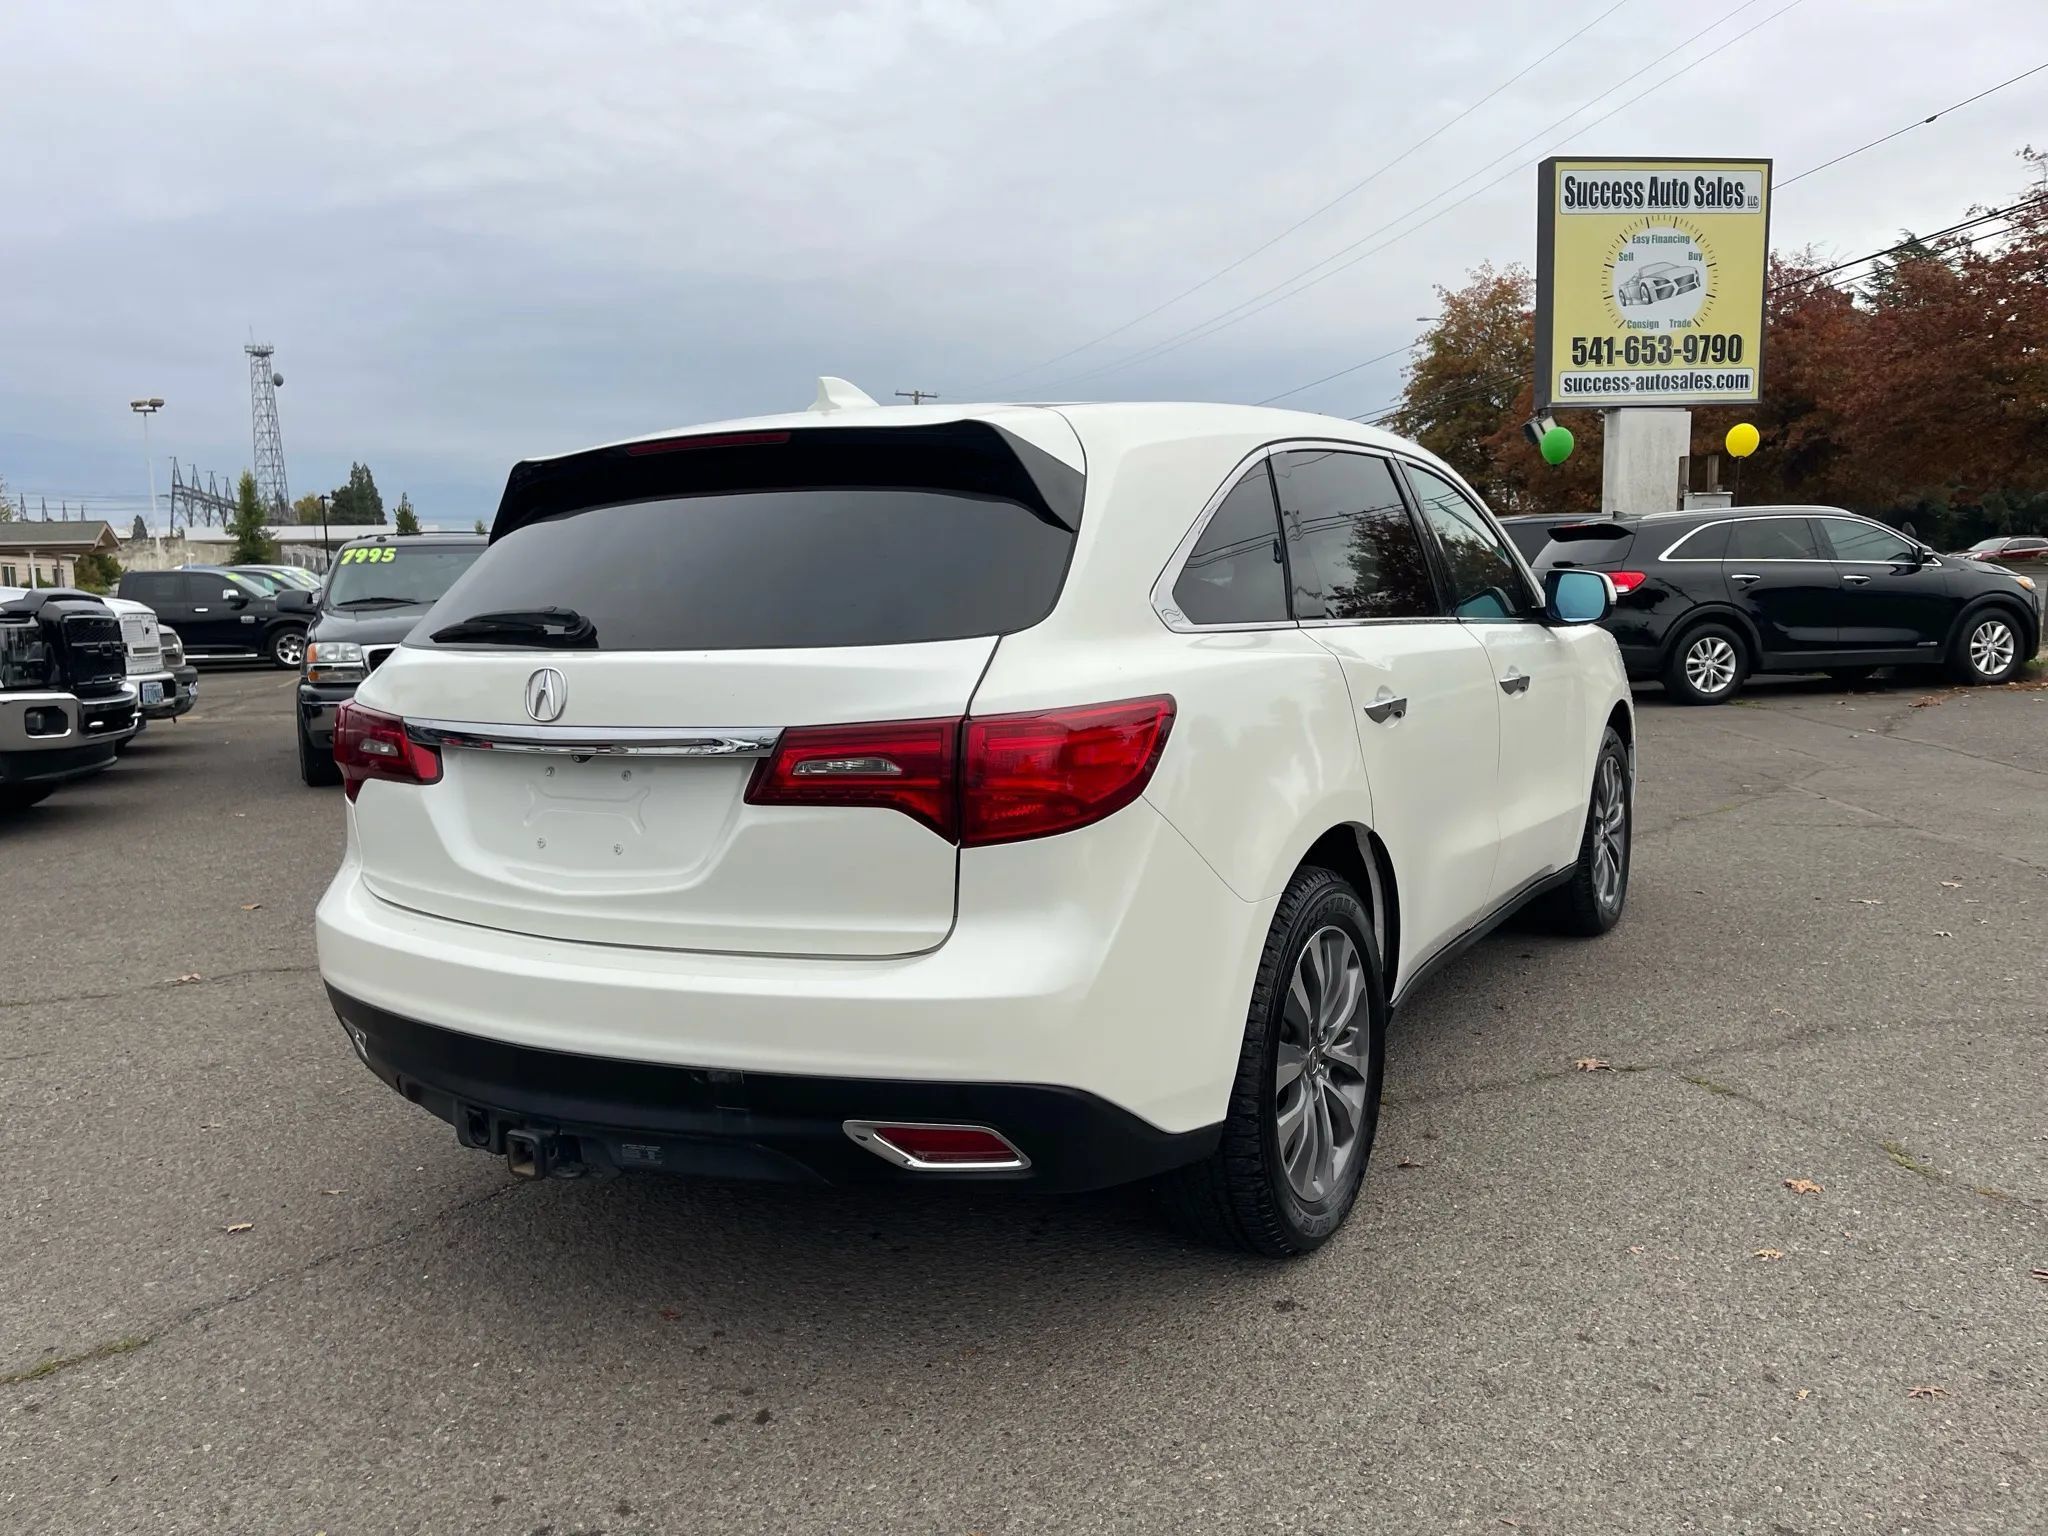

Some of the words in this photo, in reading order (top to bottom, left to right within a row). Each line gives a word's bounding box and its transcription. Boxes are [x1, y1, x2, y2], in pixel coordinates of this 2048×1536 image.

[1564, 175, 1645, 210] Success
[1647, 176, 1690, 208] Auto
[1694, 175, 1746, 209] Sales
[1747, 195, 1759, 207] LLC
[1632, 234, 1651, 245] Easy
[1651, 234, 1691, 246] Financing
[1618, 252, 1634, 262] Sell
[1688, 252, 1703, 263] Buy
[1627, 319, 1660, 331] Consign
[1669, 318, 1692, 329] Trade
[1572, 334, 1744, 366] 541-653-9790
[1564, 371, 1750, 394] success-autosales.com
